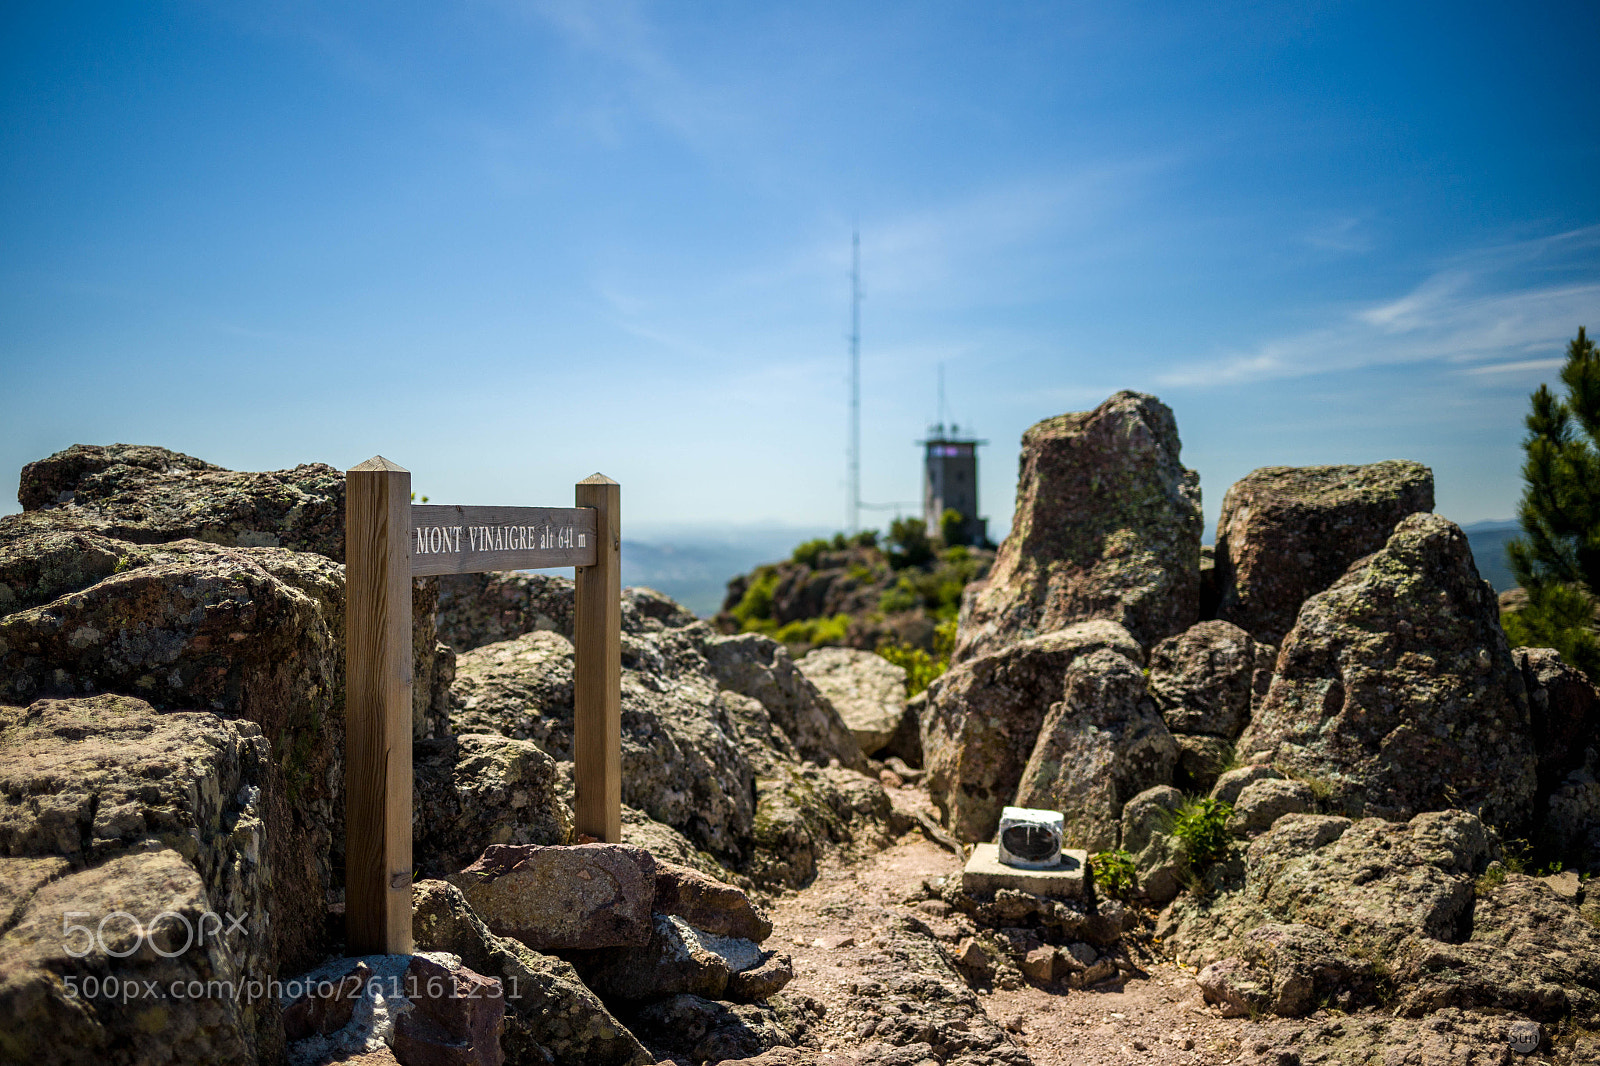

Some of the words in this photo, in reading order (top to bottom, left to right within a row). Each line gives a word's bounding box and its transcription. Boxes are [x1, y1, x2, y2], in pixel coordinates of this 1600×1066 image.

[416, 526, 462, 554] MONT
[469, 525, 535, 551] VINAIGRE
[540, 525, 554, 550] alt
[558, 526, 574, 549] 641
[578, 533, 586, 547] m
